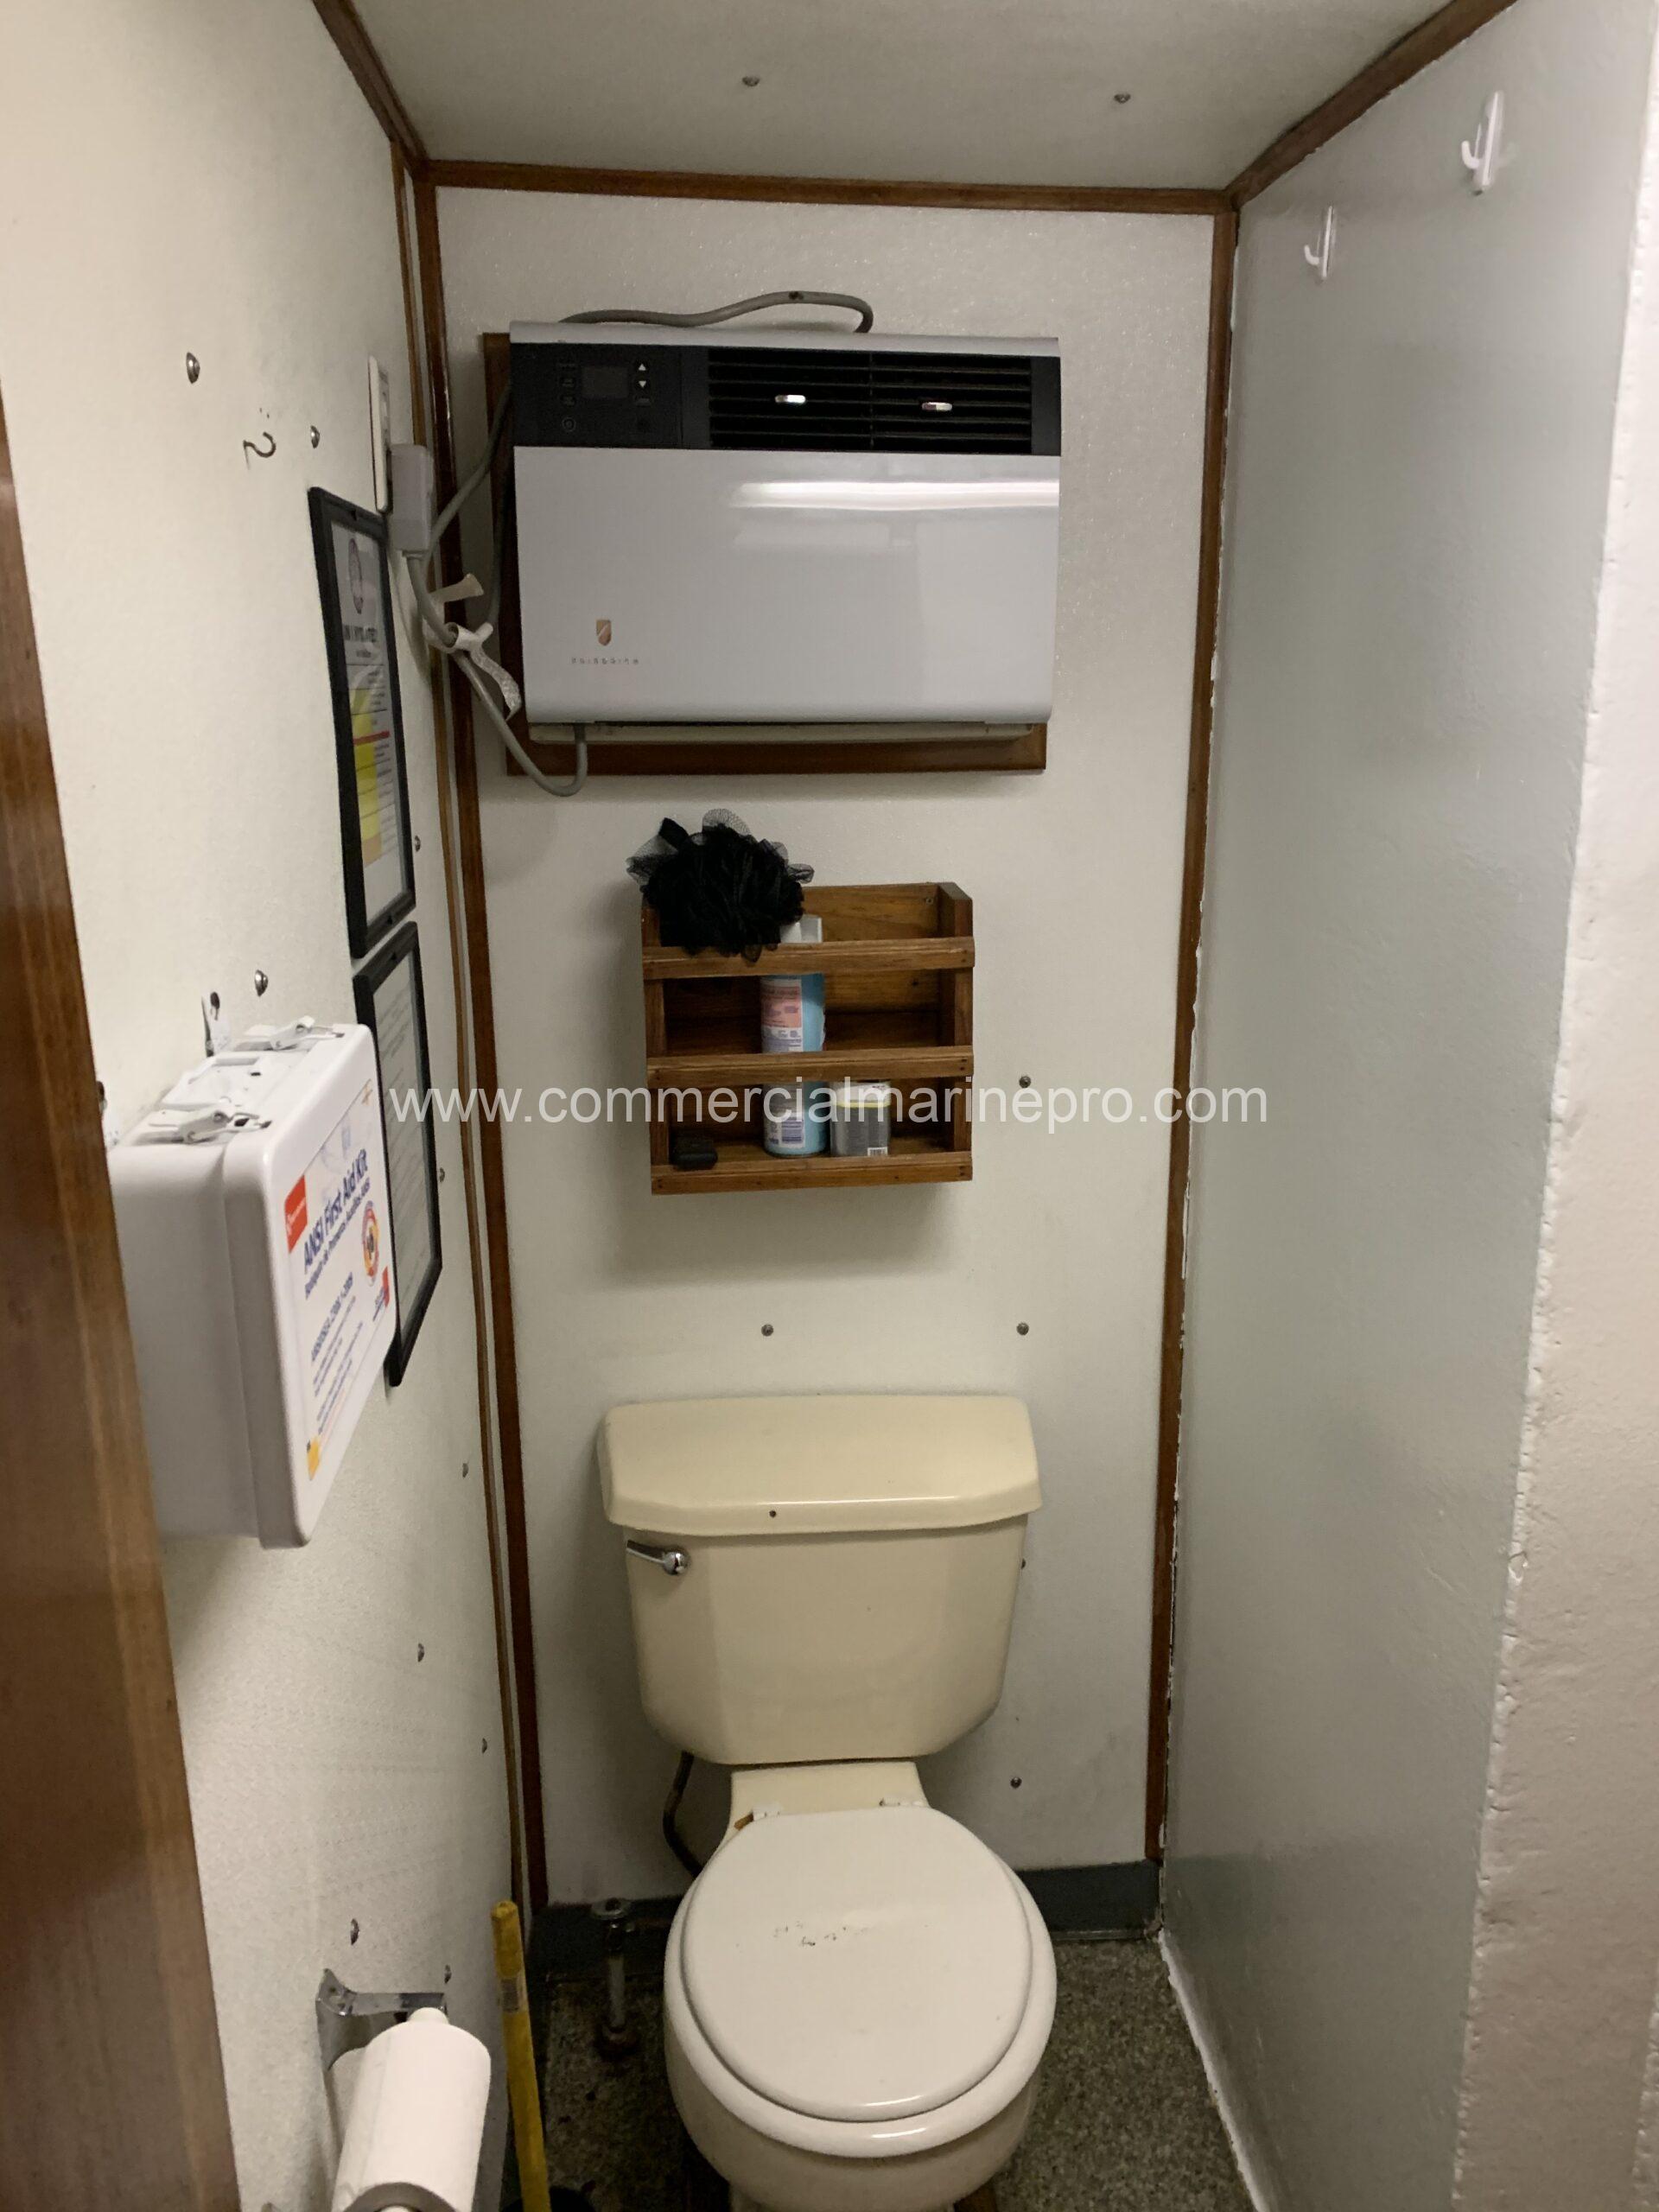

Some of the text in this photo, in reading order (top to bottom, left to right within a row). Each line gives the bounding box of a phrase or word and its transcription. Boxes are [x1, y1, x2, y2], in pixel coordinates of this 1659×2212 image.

[304, 1148, 368, 1274] ANSI First Aid Kit
